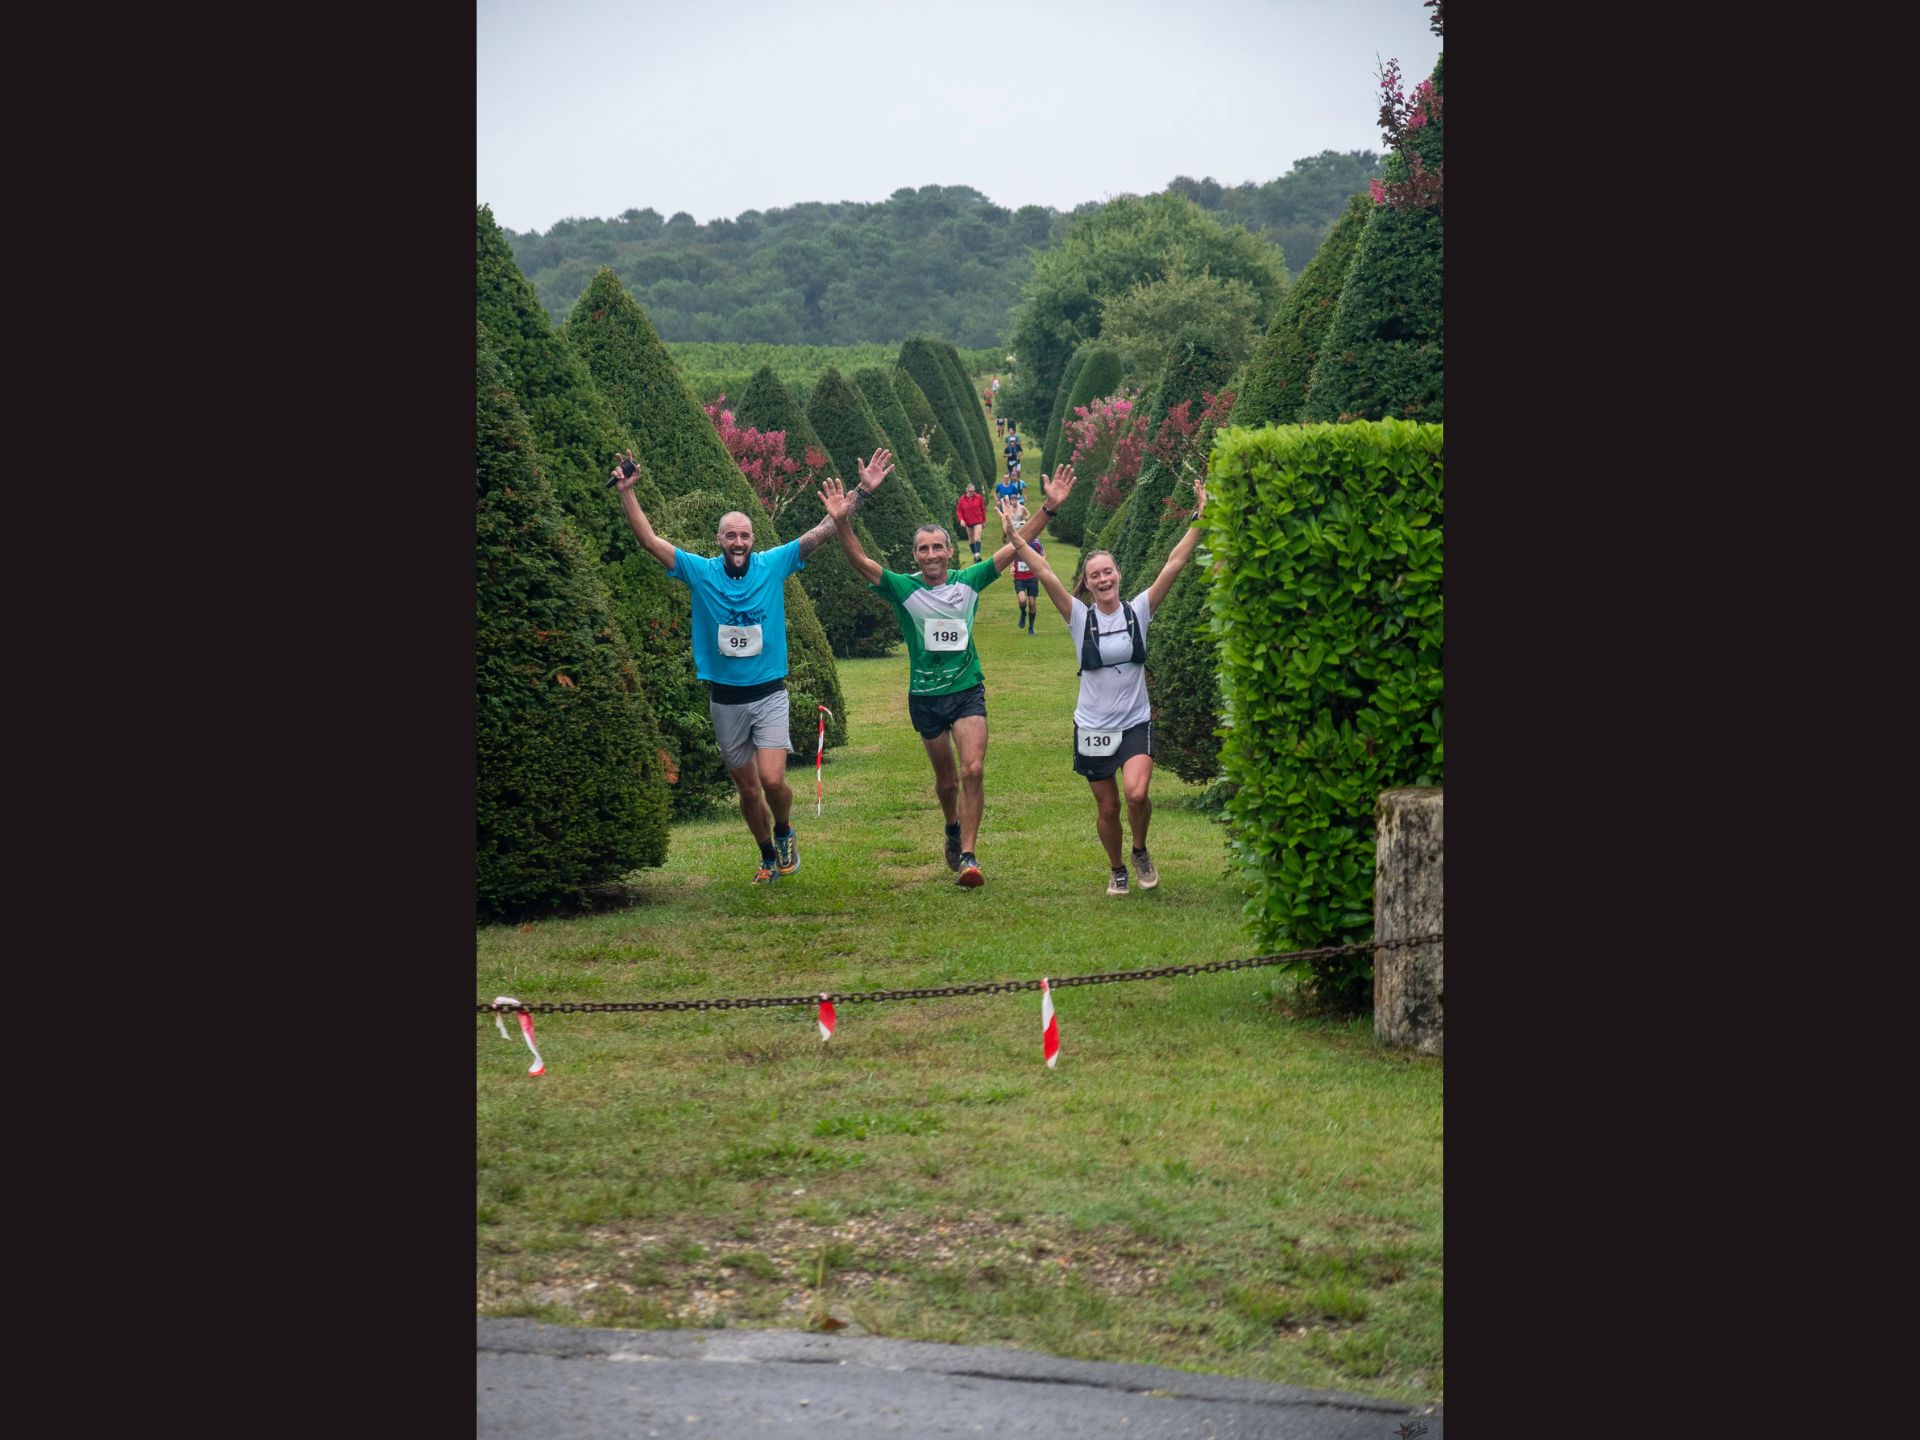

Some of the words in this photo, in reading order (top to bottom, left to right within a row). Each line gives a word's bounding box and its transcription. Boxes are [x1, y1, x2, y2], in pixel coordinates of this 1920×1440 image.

[933, 631, 958, 642] 198
[730, 637, 747, 648] 95
[1084, 735, 1111, 747] 130
